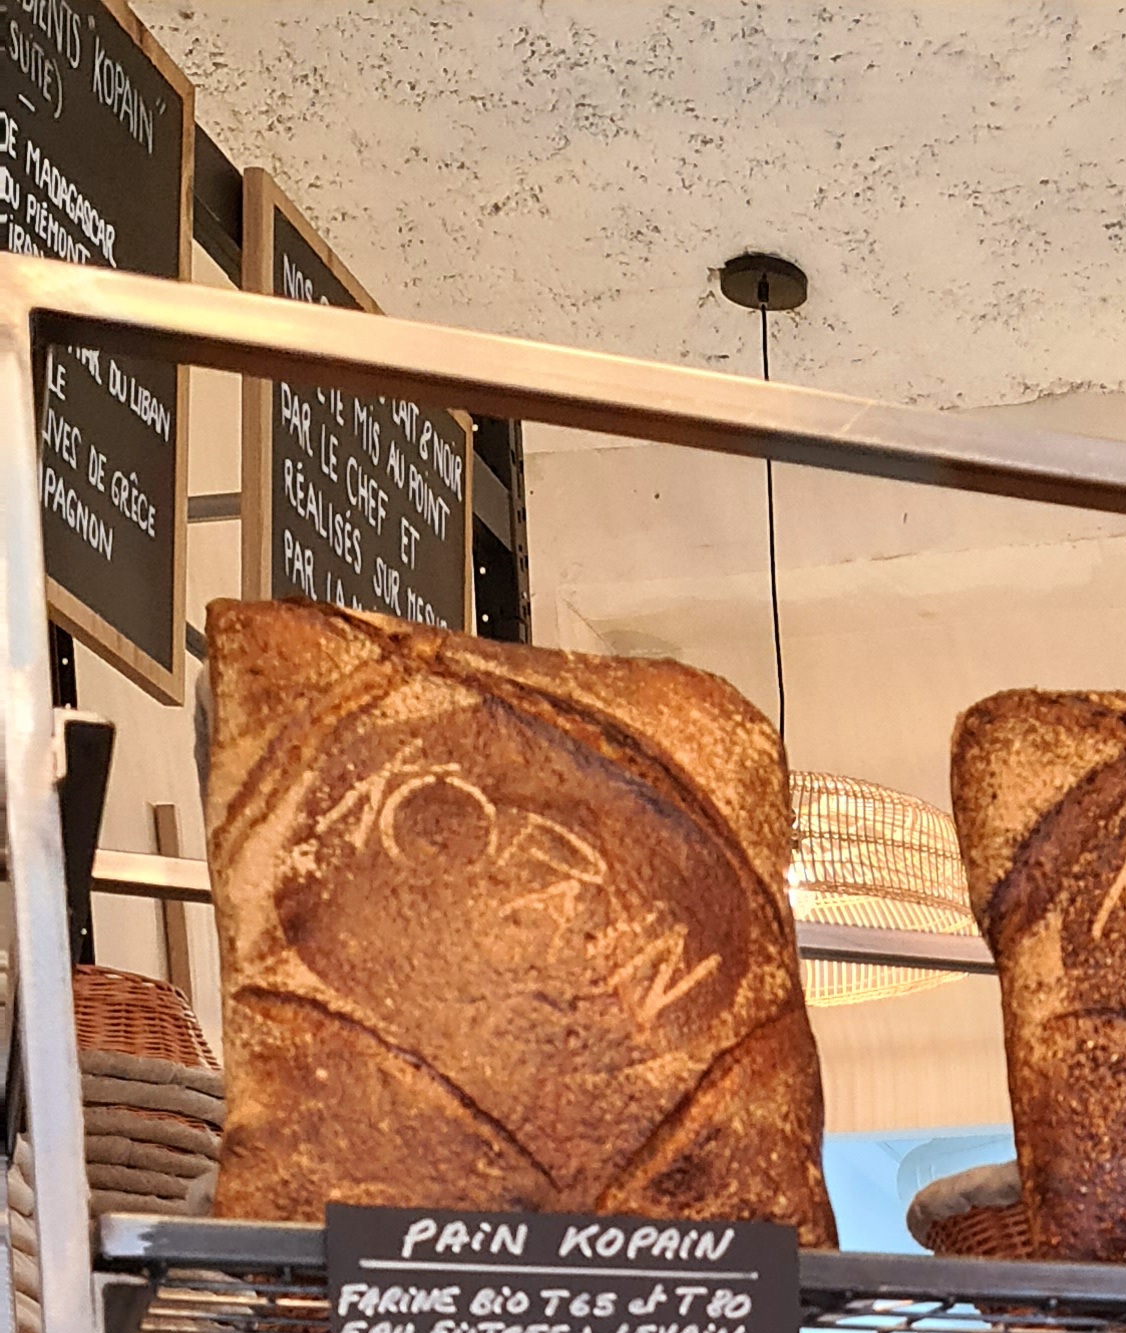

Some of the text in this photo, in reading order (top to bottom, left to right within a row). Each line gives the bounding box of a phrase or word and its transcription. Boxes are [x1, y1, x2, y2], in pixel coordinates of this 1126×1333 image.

[25, 140, 117, 268] MADAGASCAR
[108, 359, 127, 403] DU
[129, 377, 170, 442] LIBAN
[88, 444, 107, 493] DE
[281, 382, 313, 457] PAR
[320, 424, 339, 482] LE
[346, 456, 389, 535] CHEF
[401, 516, 420, 570] ET
[353, 397, 451, 541] MIS AU POINT
[433, 430, 463, 502] NOIR
[284, 458, 362, 575] RÉALISÉS
[372, 557, 401, 617] SUR
[284, 529, 318, 601] PAR
[401, 1218, 735, 1262] PAIN KOPAIN
[337, 1283, 461, 1316] FARINE
[469, 1284, 530, 1315] BIO
